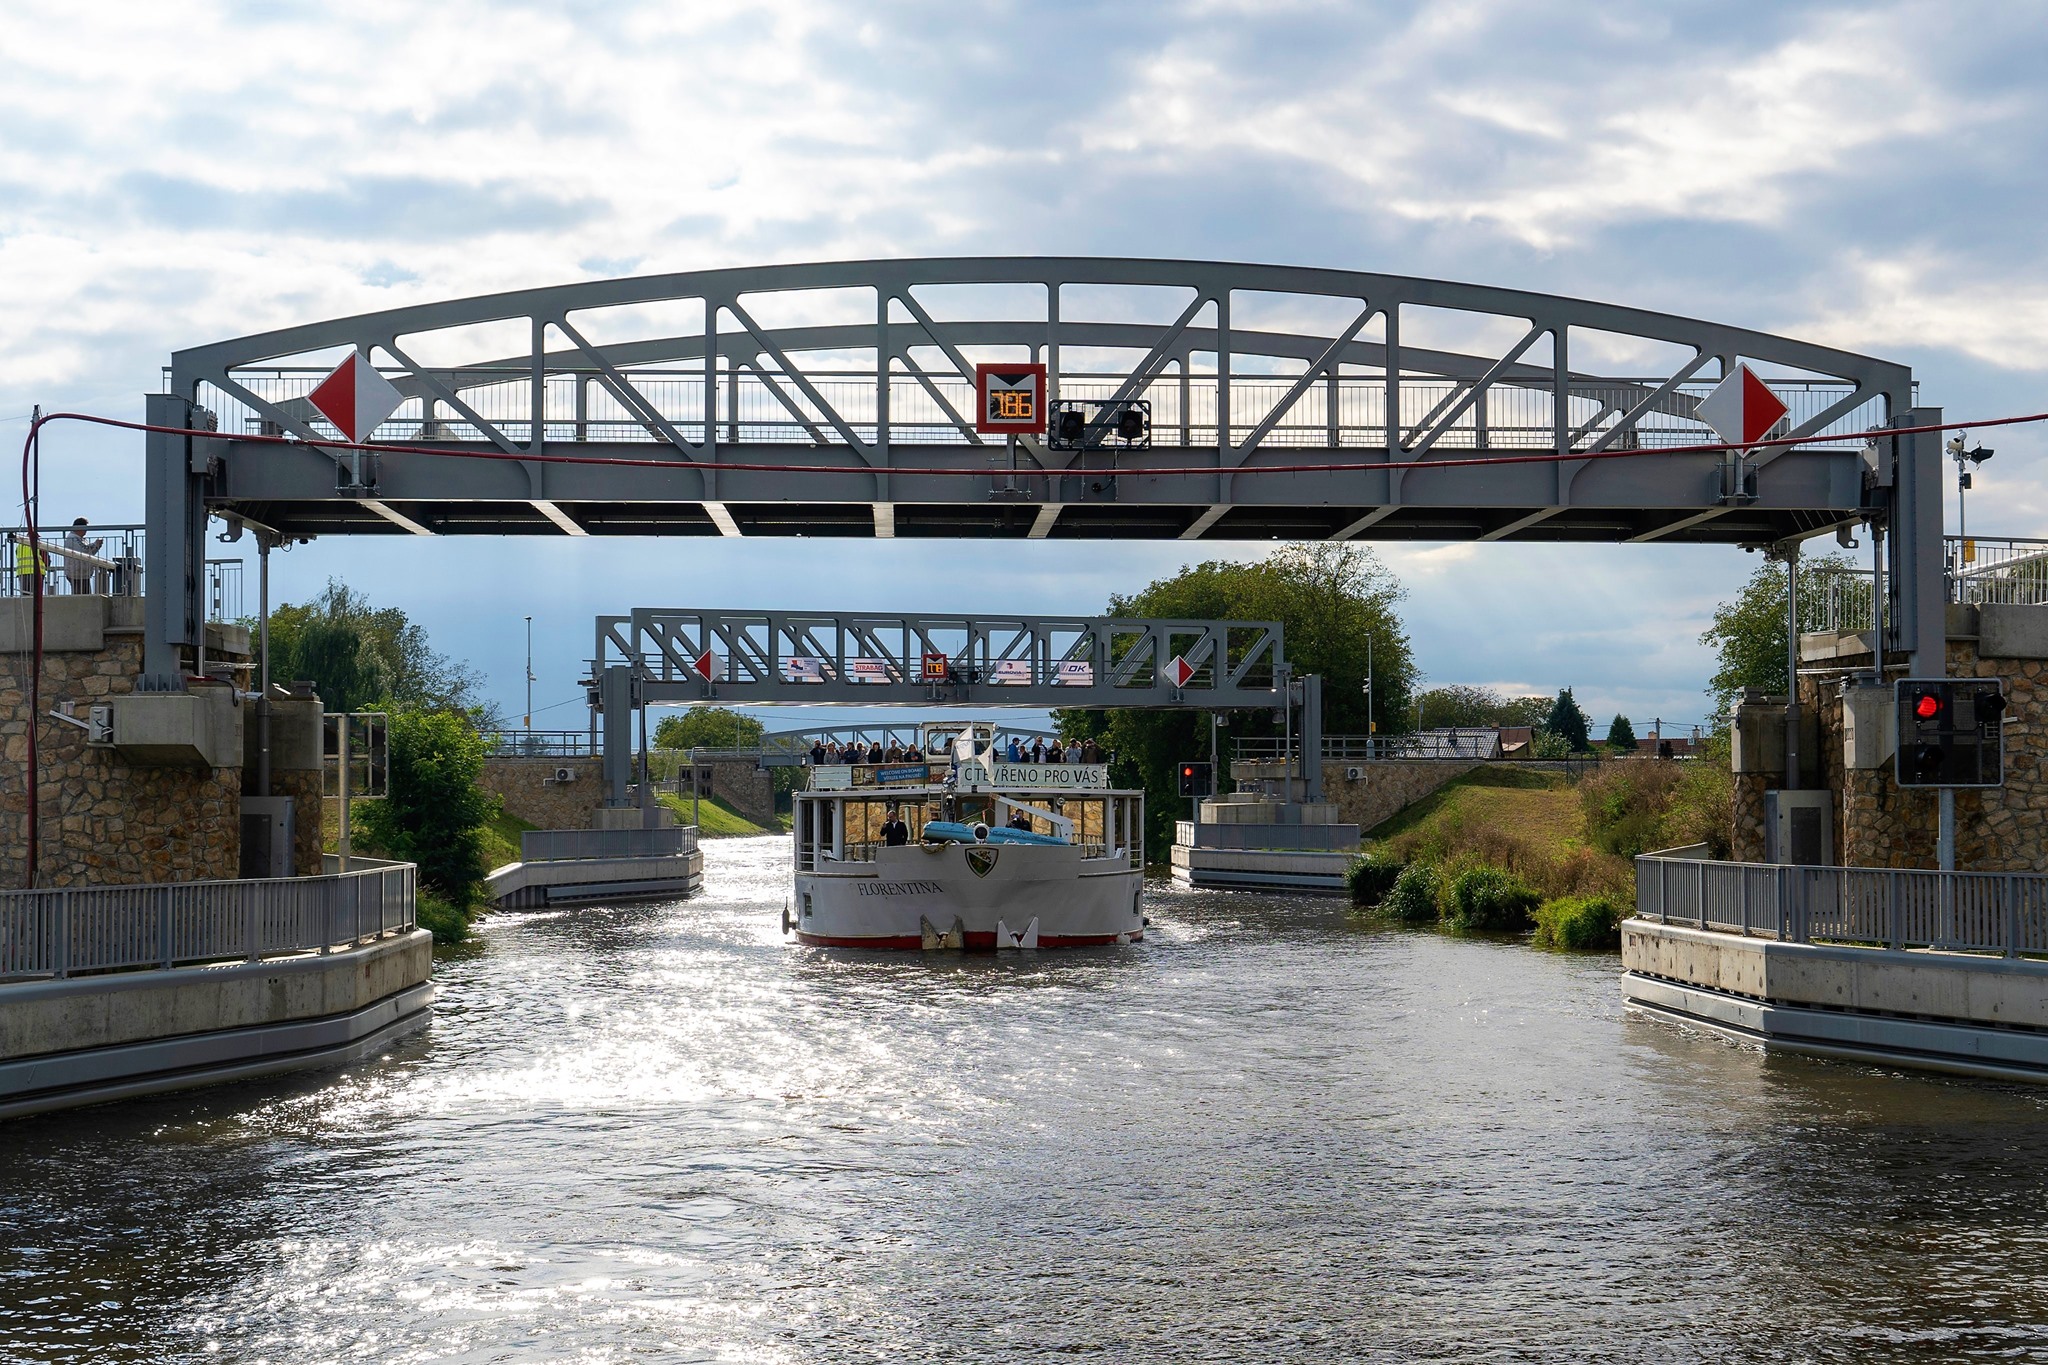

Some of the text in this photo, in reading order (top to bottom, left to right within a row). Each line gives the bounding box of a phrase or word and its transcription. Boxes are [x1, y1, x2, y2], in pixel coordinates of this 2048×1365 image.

[1044, 769, 1070, 783] PRO
[1073, 767, 1099, 783] VÁS
[857, 881, 944, 896] FLORENTINA
